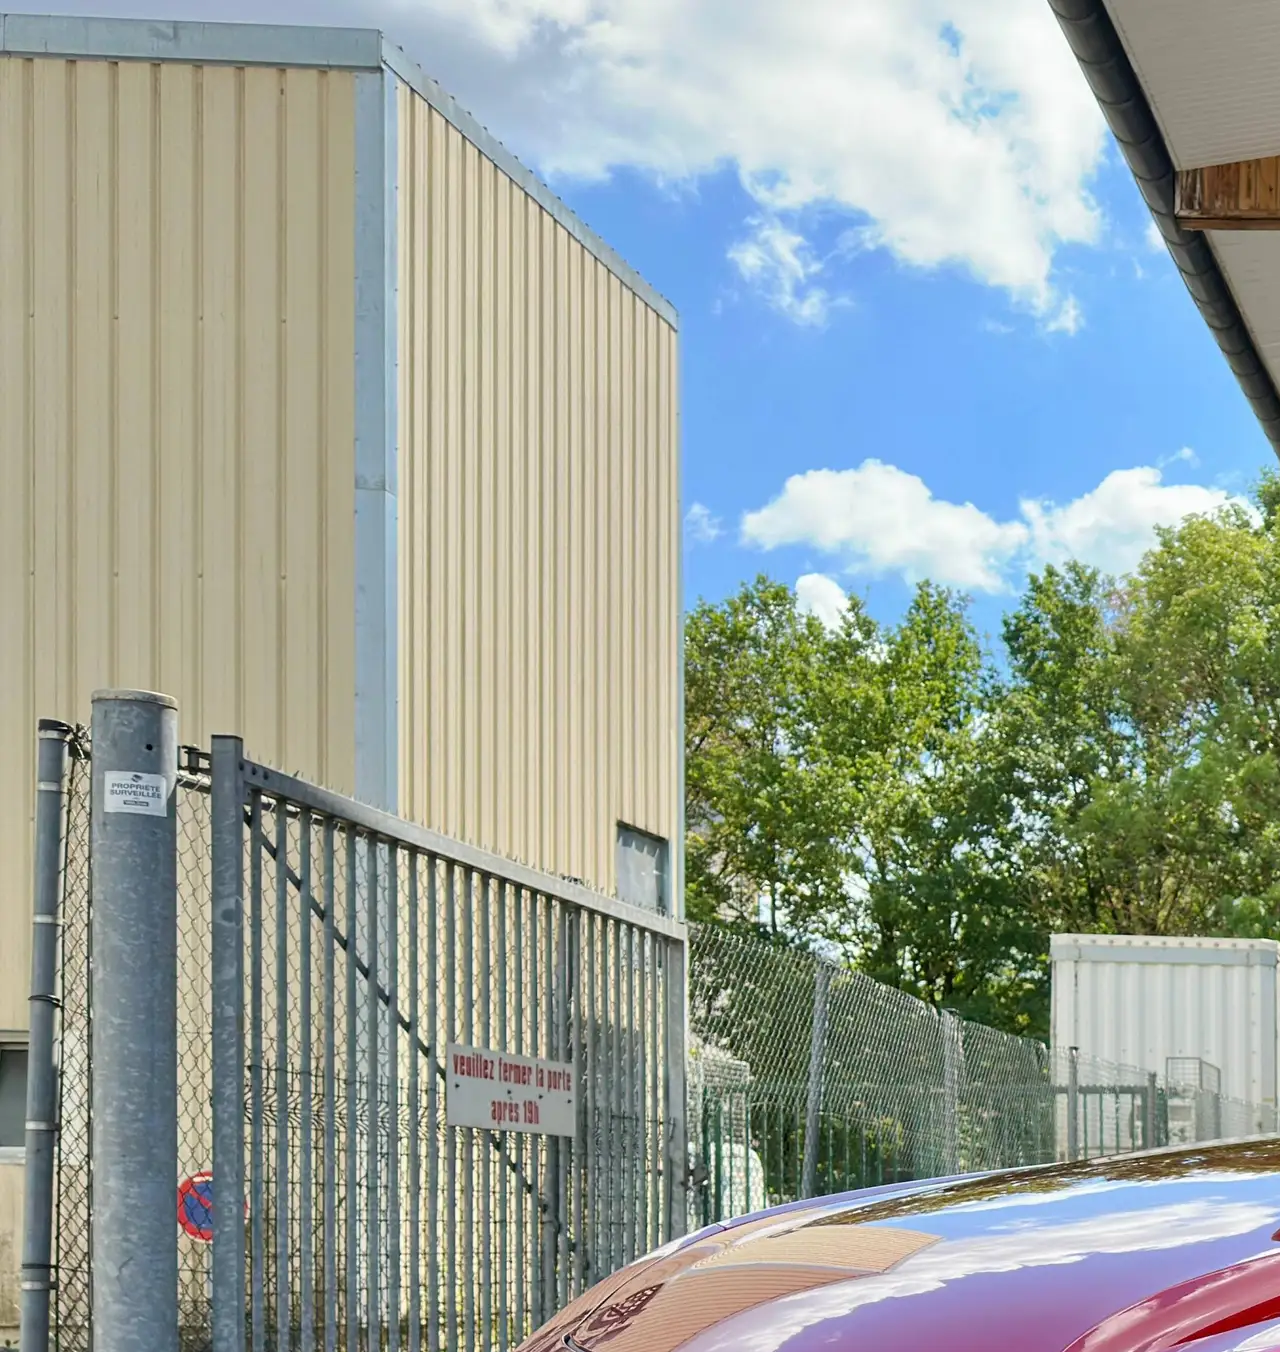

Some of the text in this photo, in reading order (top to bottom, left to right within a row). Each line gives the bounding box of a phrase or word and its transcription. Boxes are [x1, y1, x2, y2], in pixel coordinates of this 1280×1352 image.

[453, 1052, 571, 1092] veuillez fermer la porte
[523, 1101, 540, 1125] 19h
